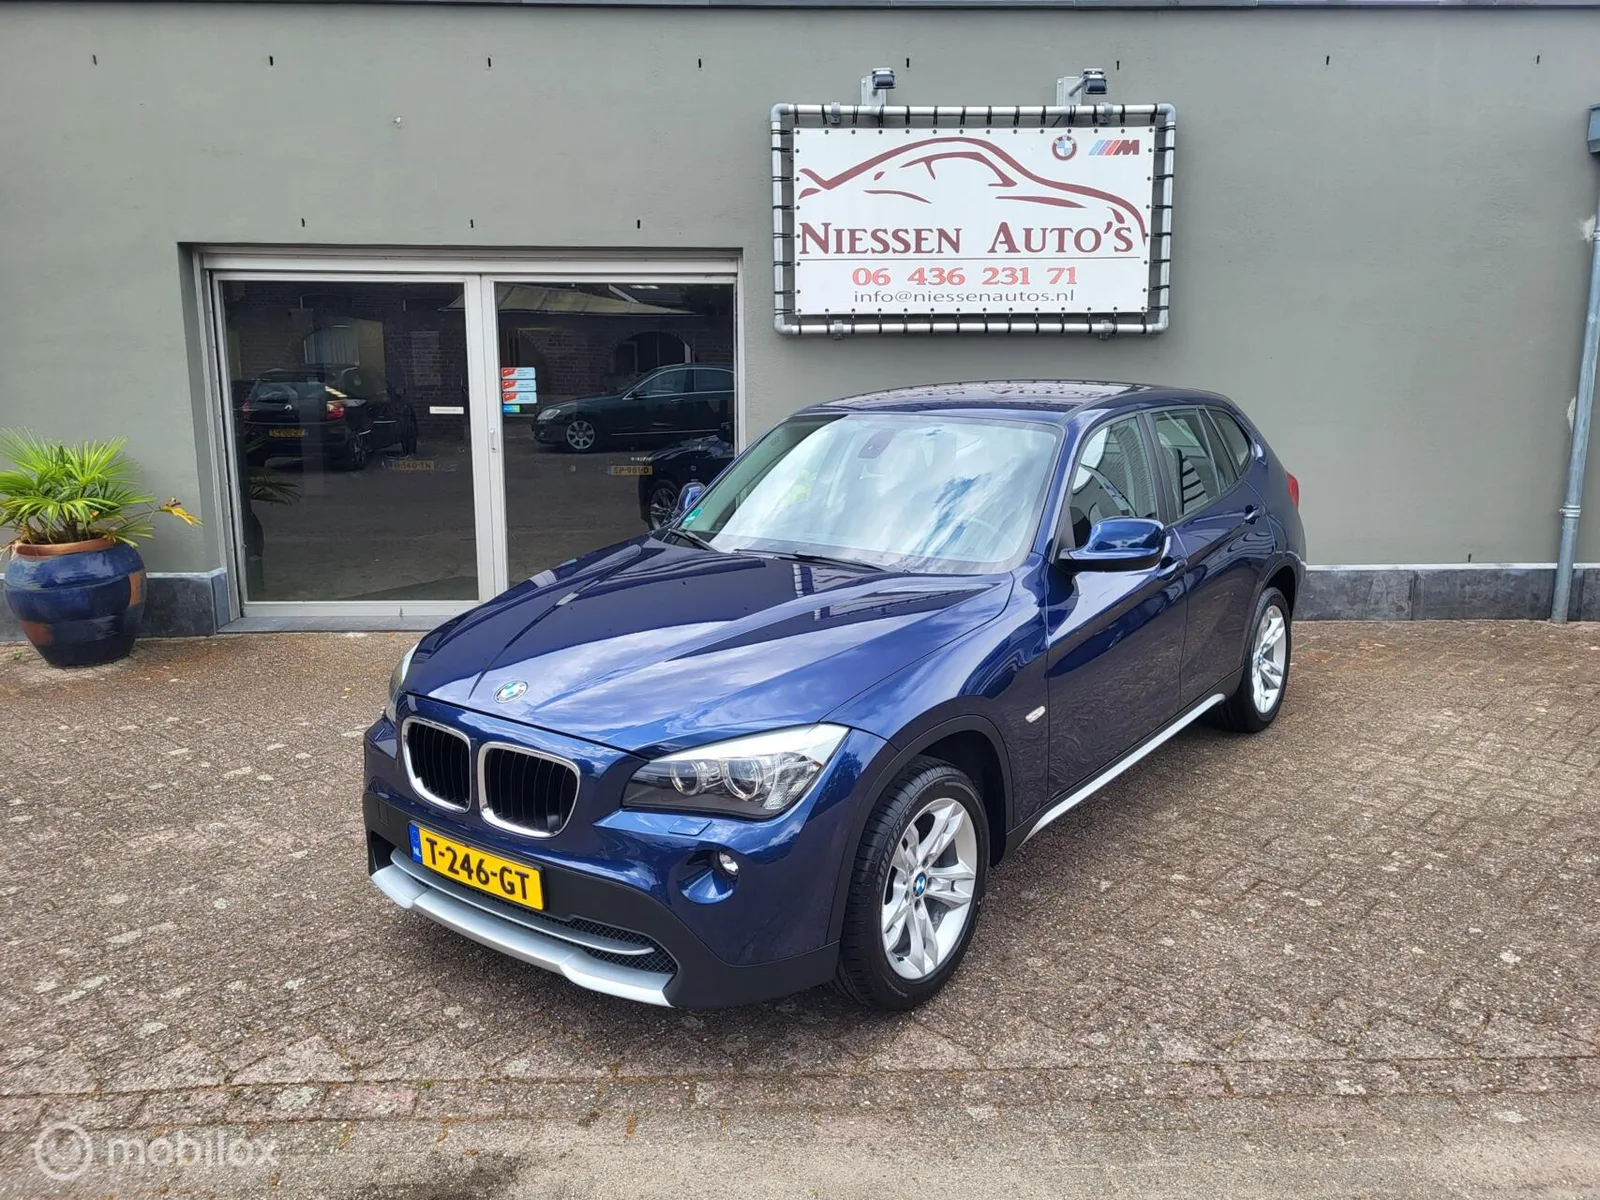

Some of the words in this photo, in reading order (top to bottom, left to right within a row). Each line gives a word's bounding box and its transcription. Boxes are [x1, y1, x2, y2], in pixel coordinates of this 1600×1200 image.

[799, 222, 962, 254] NIESSEN
[987, 221, 1134, 254] AUTO'S
[852, 267, 891, 286] 06
[907, 267, 966, 286] 436
[982, 267, 1030, 286] 231
[1047, 266, 1077, 285] 71
[854, 290, 1074, 303] info@niessenautos.nl
[413, 847, 422, 858] NL
[426, 836, 530, 900] T-246-GT
